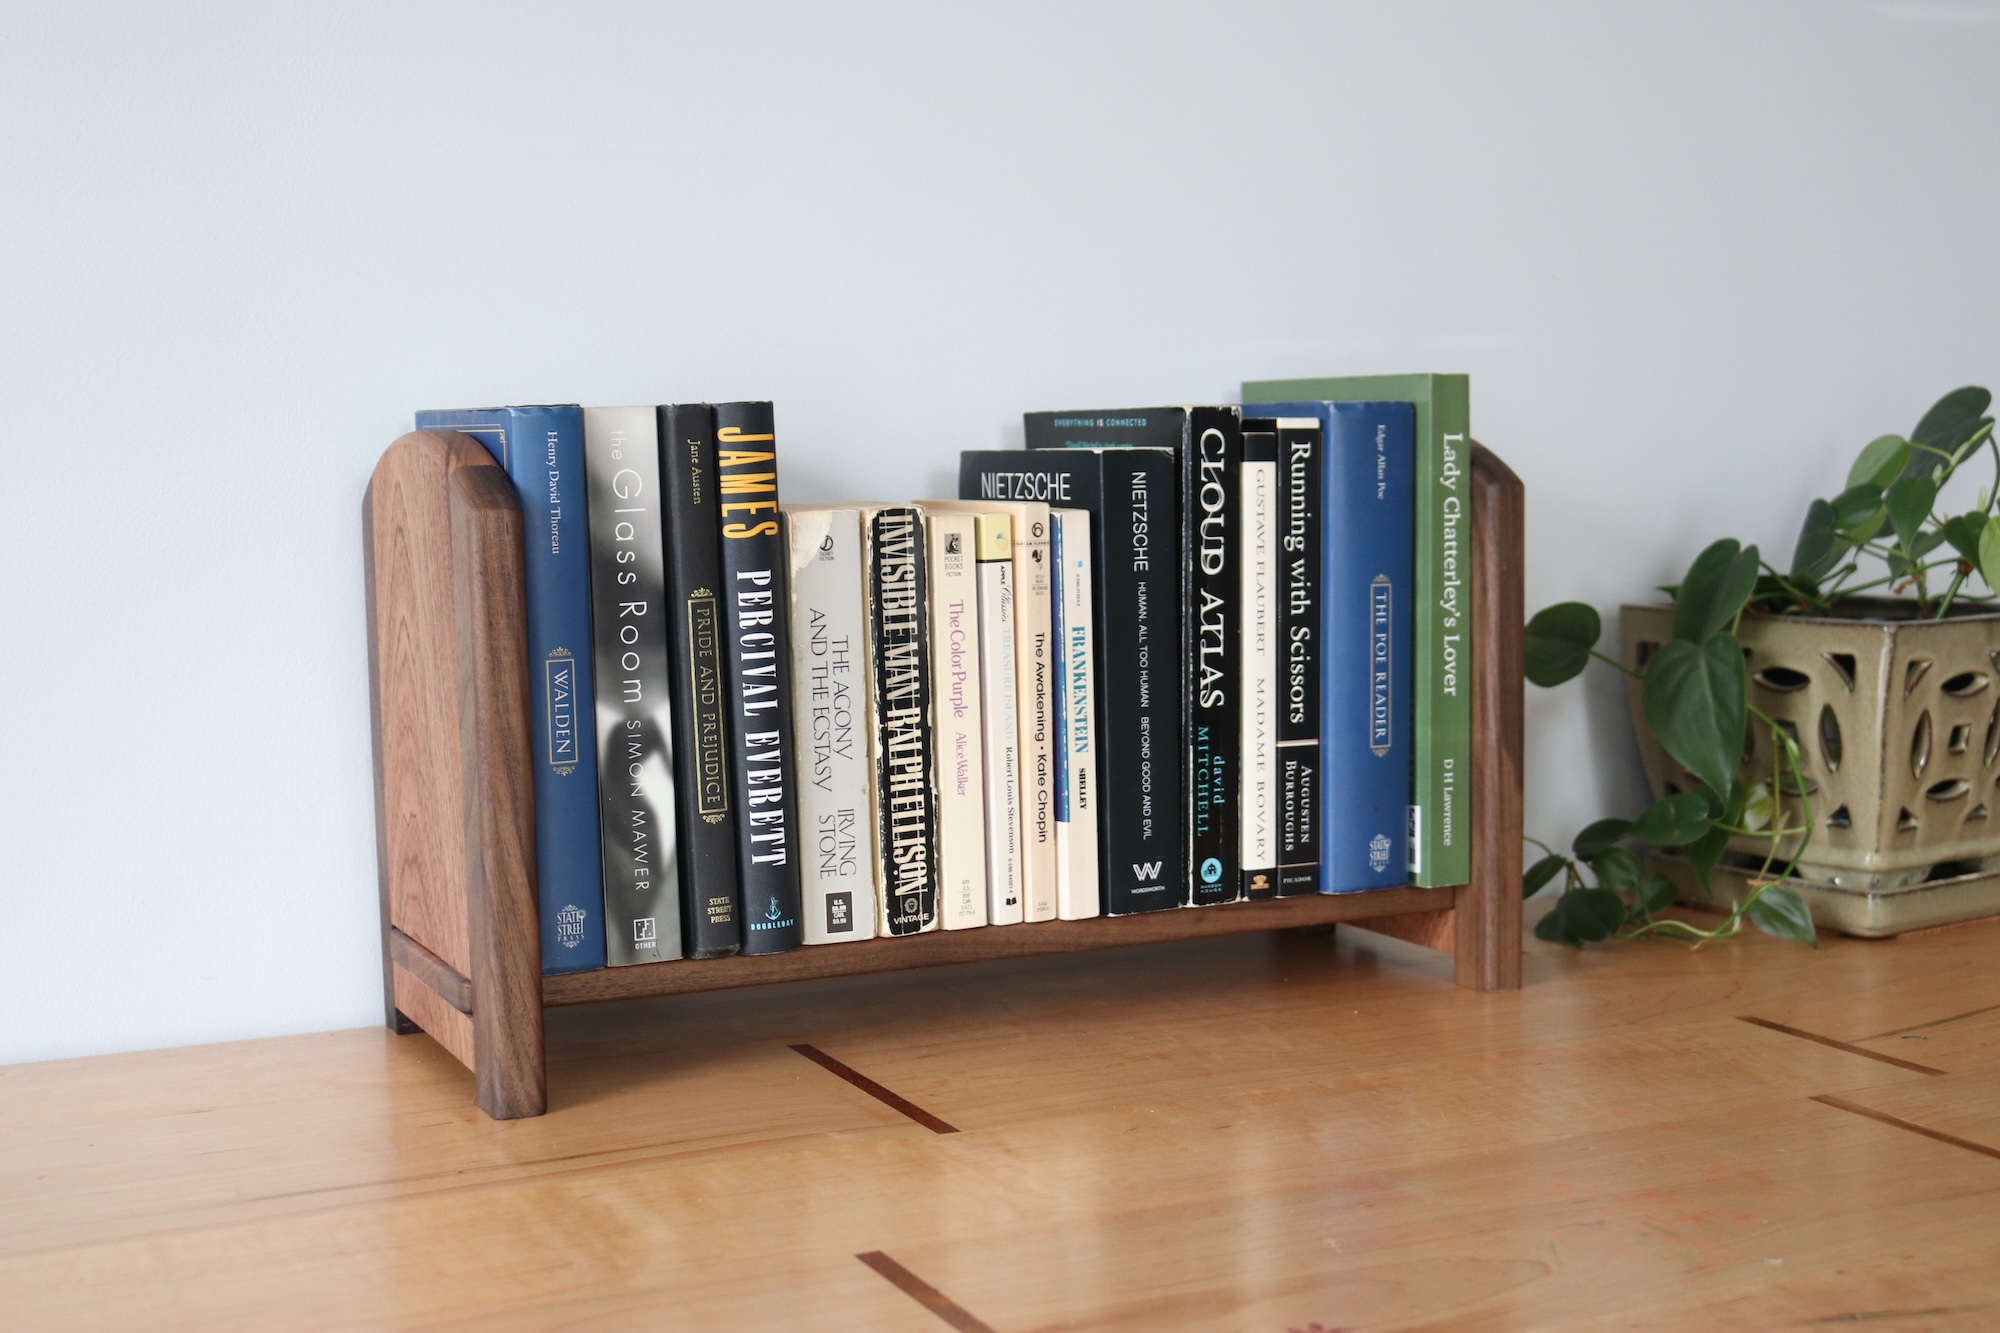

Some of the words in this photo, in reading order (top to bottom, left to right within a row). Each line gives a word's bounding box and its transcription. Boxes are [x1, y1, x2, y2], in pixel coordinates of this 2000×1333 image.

[1054, 418, 1095, 427] EVERYTHING
[1096, 418, 1104, 427] IS
[1105, 418, 1147, 427] CONNECTED
[1375, 424, 1387, 454] Edgar
[547, 431, 559, 468] Henry
[610, 431, 628, 460] the
[687, 438, 701, 464] Jane
[1376, 455, 1388, 478] Allan
[1439, 433, 1464, 491] Lady
[548, 470, 561, 504] David
[691, 467, 703, 505] Austen
[716, 426, 779, 539] JAMES
[981, 471, 1071, 500] NIETZSCHE
[1200, 428, 1226, 575] CLOUD
[1284, 441, 1312, 552] Running
[1377, 479, 1388, 500] Poe
[550, 506, 562, 554] Thoreau
[612, 469, 646, 585] Glass
[1131, 471, 1149, 572] NIETZSCHE
[1256, 469, 1266, 555] GUSTAVE
[879, 512, 918, 638] INVISIBLE
[944, 562, 963, 570] BOOKS
[1439, 496, 1462, 628] Chatterley's
[1001, 585, 1014, 623] Classics
[1137, 581, 1149, 622] HUMAN,
[1256, 561, 1266, 656] FLAUBERT
[1290, 558, 1312, 616] with
[1375, 592, 1388, 625] THE
[697, 608, 712, 658] PRIDE
[810, 608, 828, 656] AND
[949, 600, 964, 628] The
[1139, 625, 1148, 643] ALL
[619, 600, 648, 703] Room
[736, 569, 778, 717] PERCIVAL
[832, 635, 849, 674] THE
[949, 629, 966, 669] Color
[1002, 628, 1013, 691] TREASURE
[1034, 632, 1045, 658] The
[1138, 645, 1149, 668] TOO
[1200, 588, 1226, 709] ATLAS
[1375, 632, 1388, 664] POE
[1443, 634, 1461, 696] Lover
[699, 665, 715, 705] AND
[811, 660, 829, 702] THE
[884, 641, 921, 700] MAN
[1072, 627, 1089, 753] FRANKENSTEIN
[1139, 669, 1149, 708] HUMAN
[1289, 625, 1312, 724] Scissors
[553, 669, 571, 753] WALDEN
[949, 671, 968, 718] Purple
[1034, 661, 1046, 742] Awakening
[1375, 672, 1388, 739] READER
[833, 680, 853, 760] AGONY
[1003, 695, 1014, 740] ISLAND
[1140, 716, 1150, 759] BEYOND
[1256, 678, 1266, 772] MADAME
[626, 720, 645, 797] SIMON
[702, 713, 721, 804] PREJUDICE
[812, 707, 832, 792] ECSTASY
[887, 705, 924, 792] RALPH
[955, 732, 967, 759] Alice
[1005, 747, 1014, 780] Robert
[1443, 758, 1455, 769] D
[956, 759, 969, 797] Walker
[1036, 754, 1047, 786] Kate
[1078, 768, 1087, 809] SHELLEY
[1141, 760, 1151, 792] GOOD
[1197, 726, 1209, 837] MITCHELL
[1213, 755, 1225, 804] david
[1443, 772, 1455, 784] H
[744, 729, 787, 867] EVERETT
[1006, 780, 1015, 805] Louis
[1142, 795, 1151, 817] AND
[1285, 760, 1297, 851] BURROUGHS
[1301, 765, 1313, 843] AUGUSTEN
[1007, 806, 1015, 854] Stevenson
[1036, 789, 1048, 843] Chopin
[1142, 818, 1152, 840] EVIL
[1256, 781, 1265, 861] BOVARY
[1443, 785, 1455, 846] Lawrence
[631, 809, 650, 890] MAWER
[819, 814, 837, 880] STONE
[837, 808, 856, 877] IRVING
[891, 794, 929, 896] ELLISON
[709, 896, 730, 905] STATE
[1130, 885, 1166, 894] WORDSWORTH
[1282, 876, 1312, 884] PICADOR
[557, 911, 580, 925] STATE
[557, 919, 585, 937] STREET
[707, 905, 732, 915] STREET
[710, 915, 731, 923] PRESS
[750, 919, 794, 930] DOUBLEDAY
[893, 913, 929, 925] VINTAGE
[635, 941, 656, 950] OTHER
